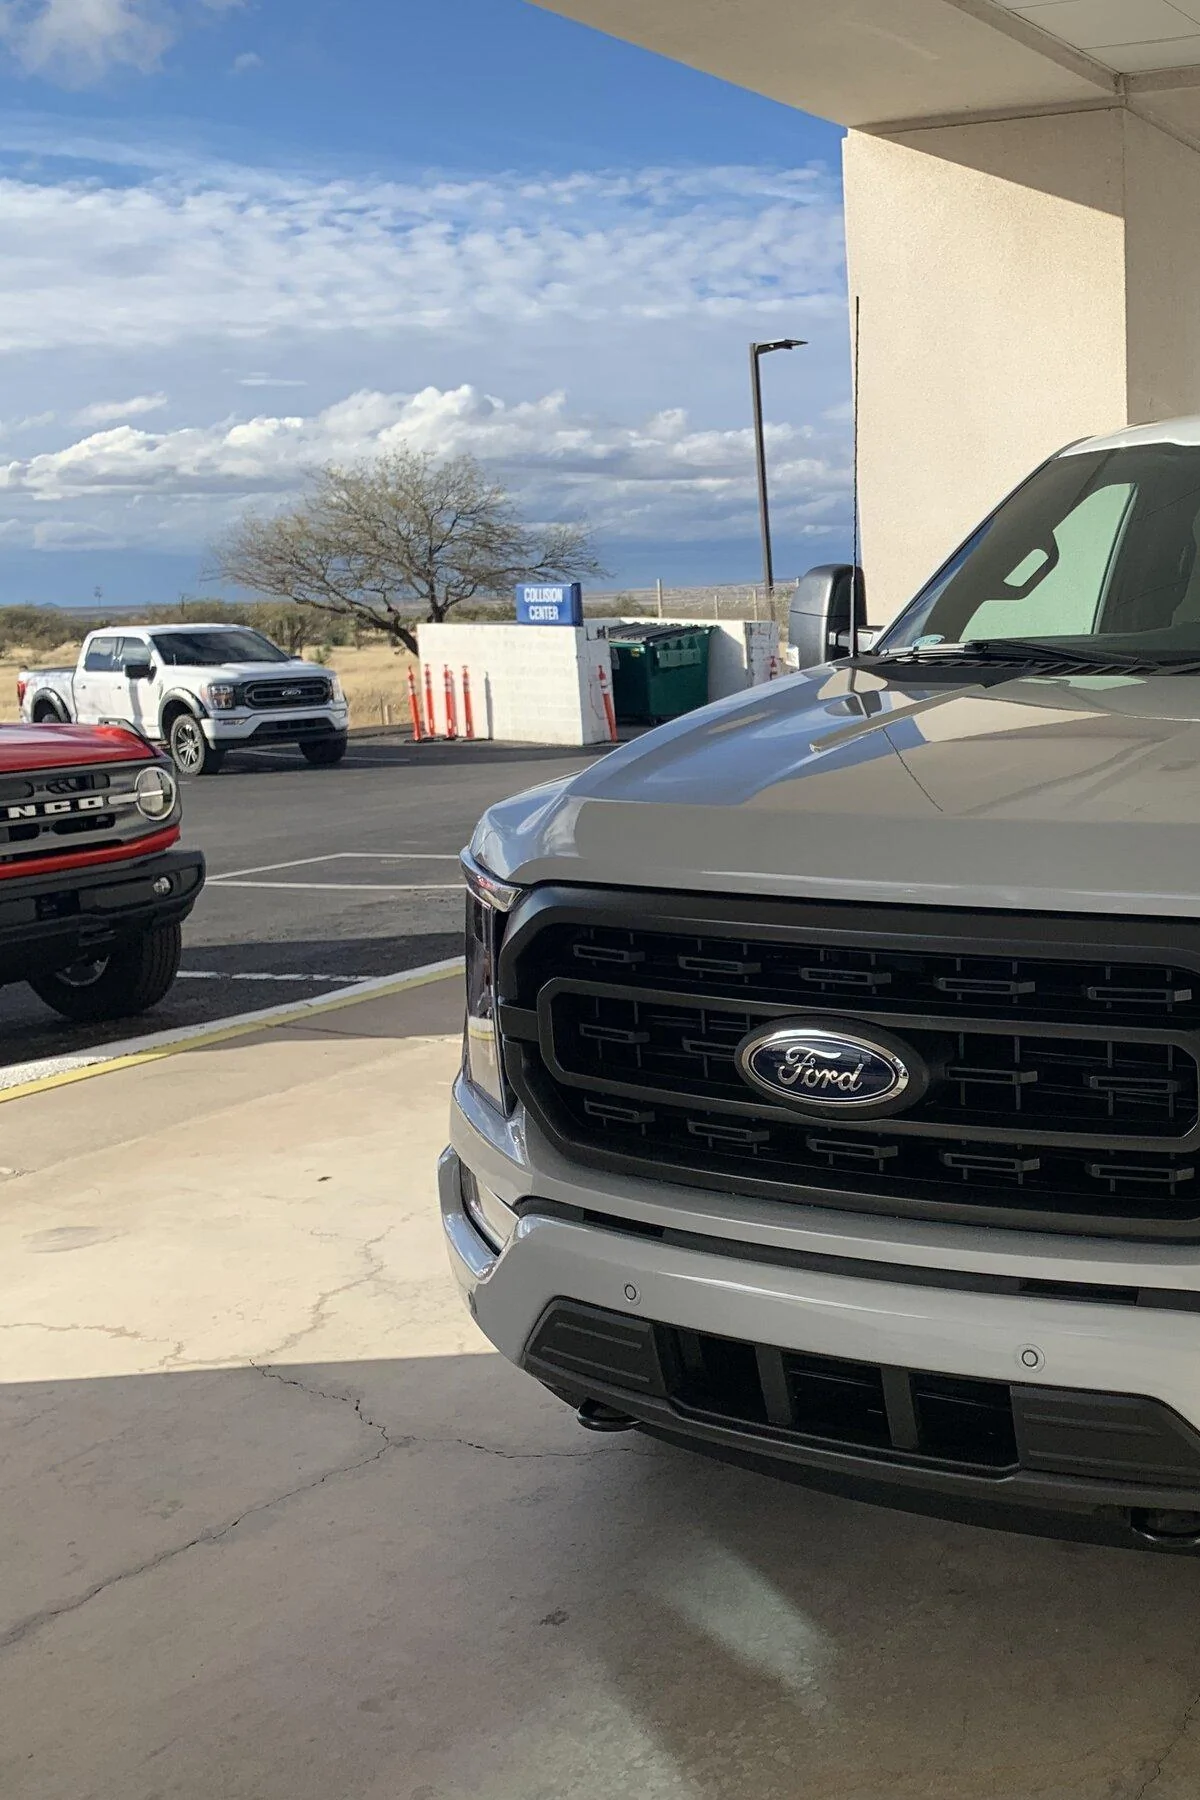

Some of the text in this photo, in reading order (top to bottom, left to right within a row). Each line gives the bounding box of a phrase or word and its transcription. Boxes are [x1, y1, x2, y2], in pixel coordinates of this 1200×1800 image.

[523, 587, 563, 603] COLLISION
[528, 605, 559, 620] CENTER
[777, 1045, 864, 1092] Ford
